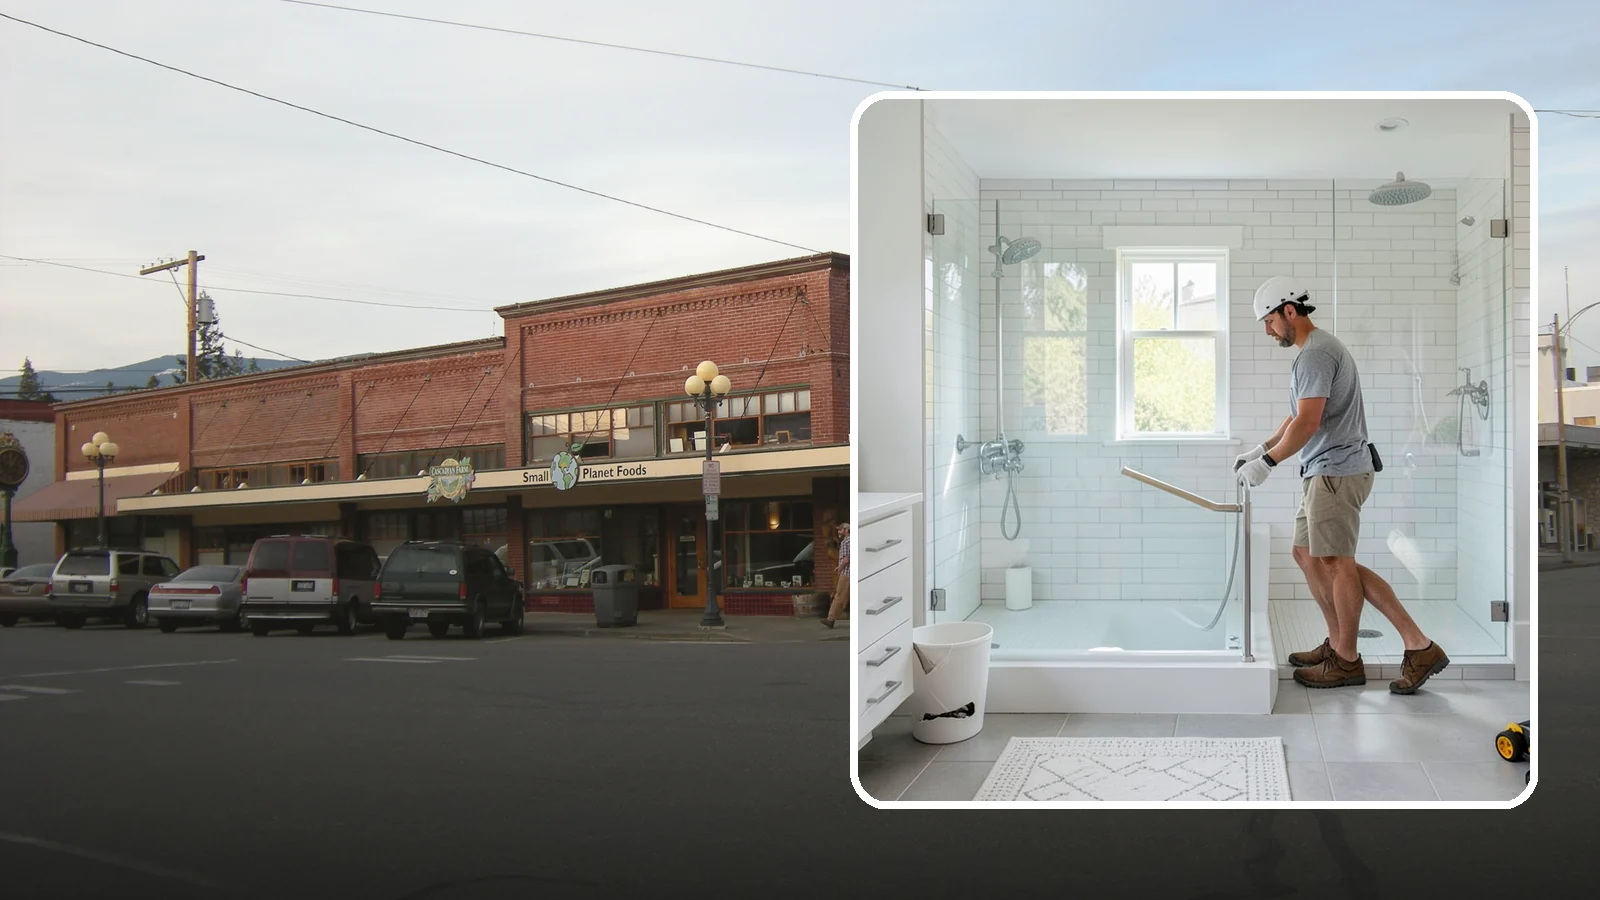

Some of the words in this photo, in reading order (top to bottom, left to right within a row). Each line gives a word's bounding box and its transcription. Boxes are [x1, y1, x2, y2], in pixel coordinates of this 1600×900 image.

[432, 467, 455, 475] CASCADIAN
[523, 471, 549, 483] Small
[583, 467, 614, 479] Planet
[617, 464, 647, 477] Foods
